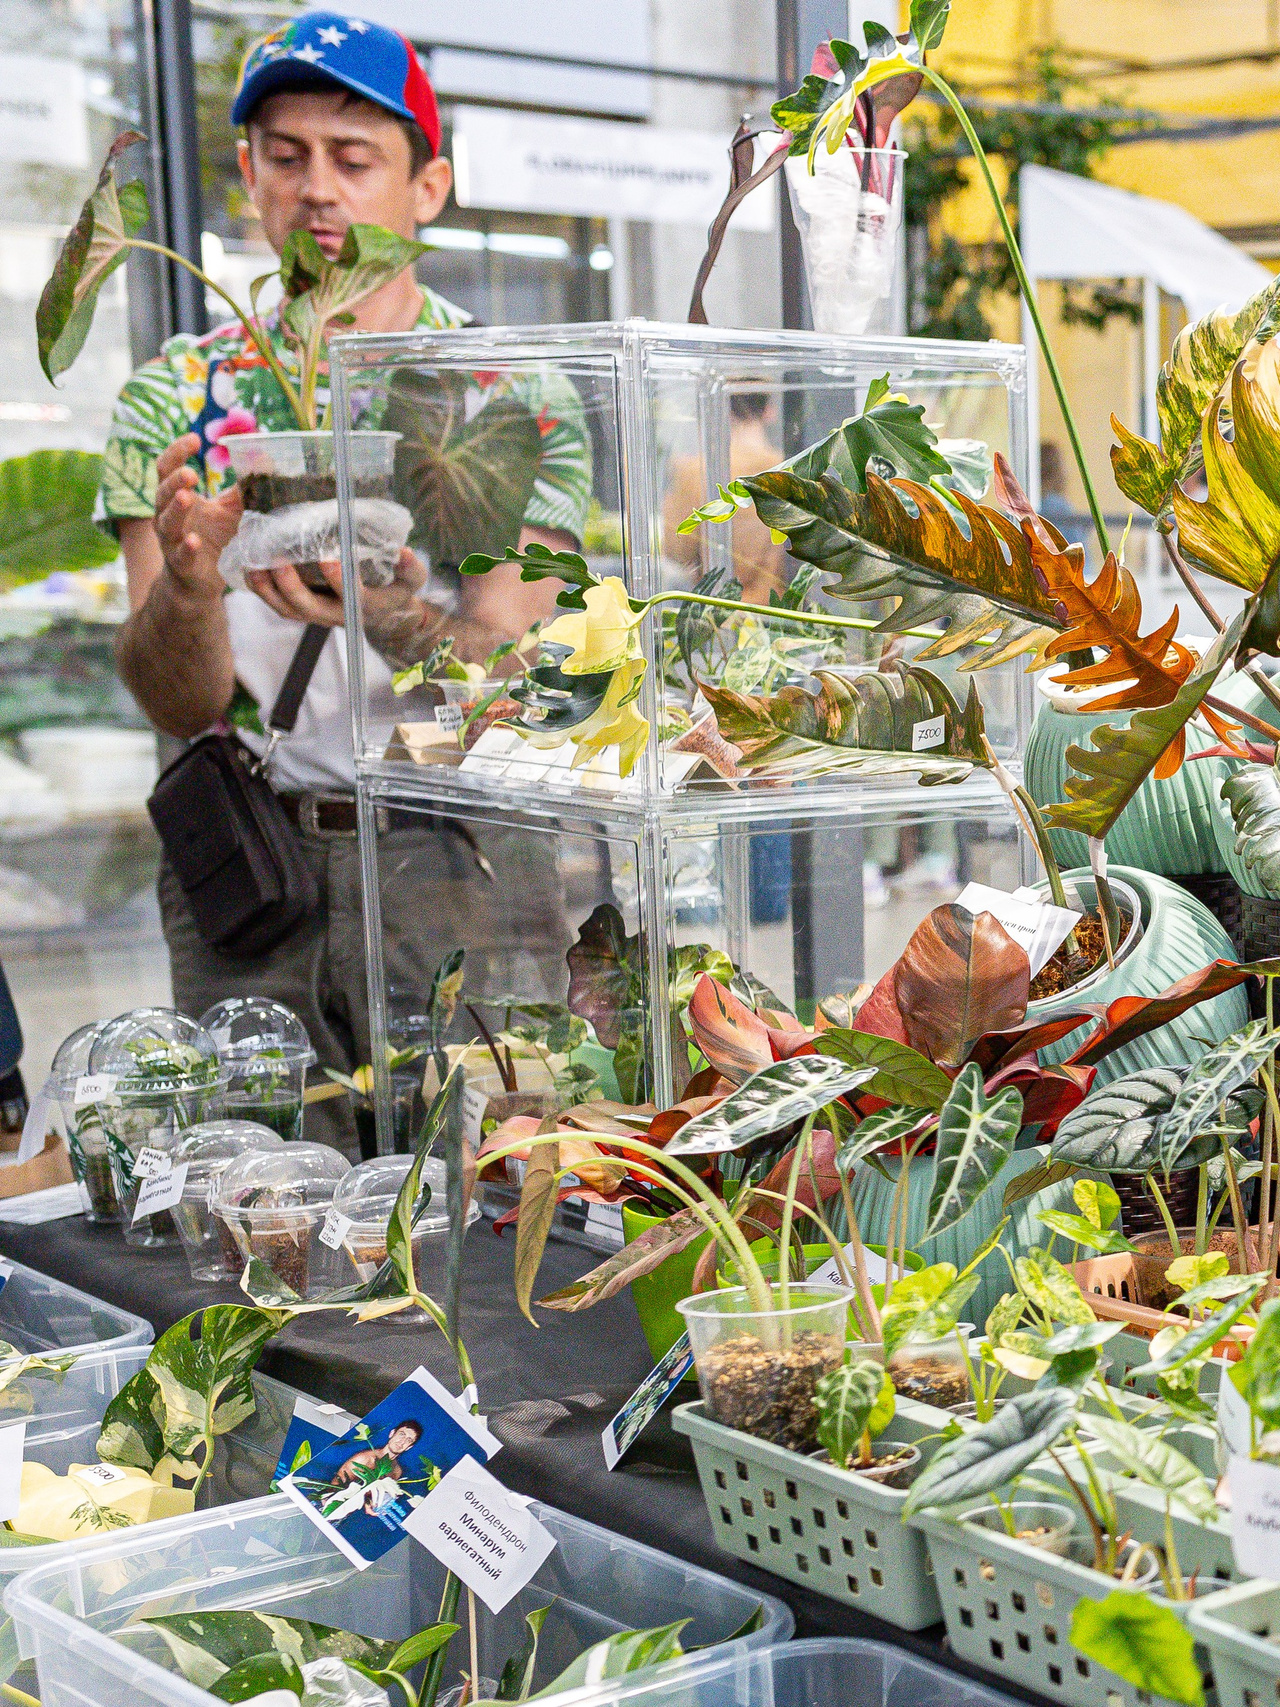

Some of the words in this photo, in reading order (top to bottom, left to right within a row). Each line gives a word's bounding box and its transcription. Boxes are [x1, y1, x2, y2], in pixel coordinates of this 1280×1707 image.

[917, 727, 942, 742] 7500
[459, 1512, 507, 1560] Минарум
[464, 1490, 528, 1554] Филодендрон
[438, 1521, 503, 1581] вариегатный
